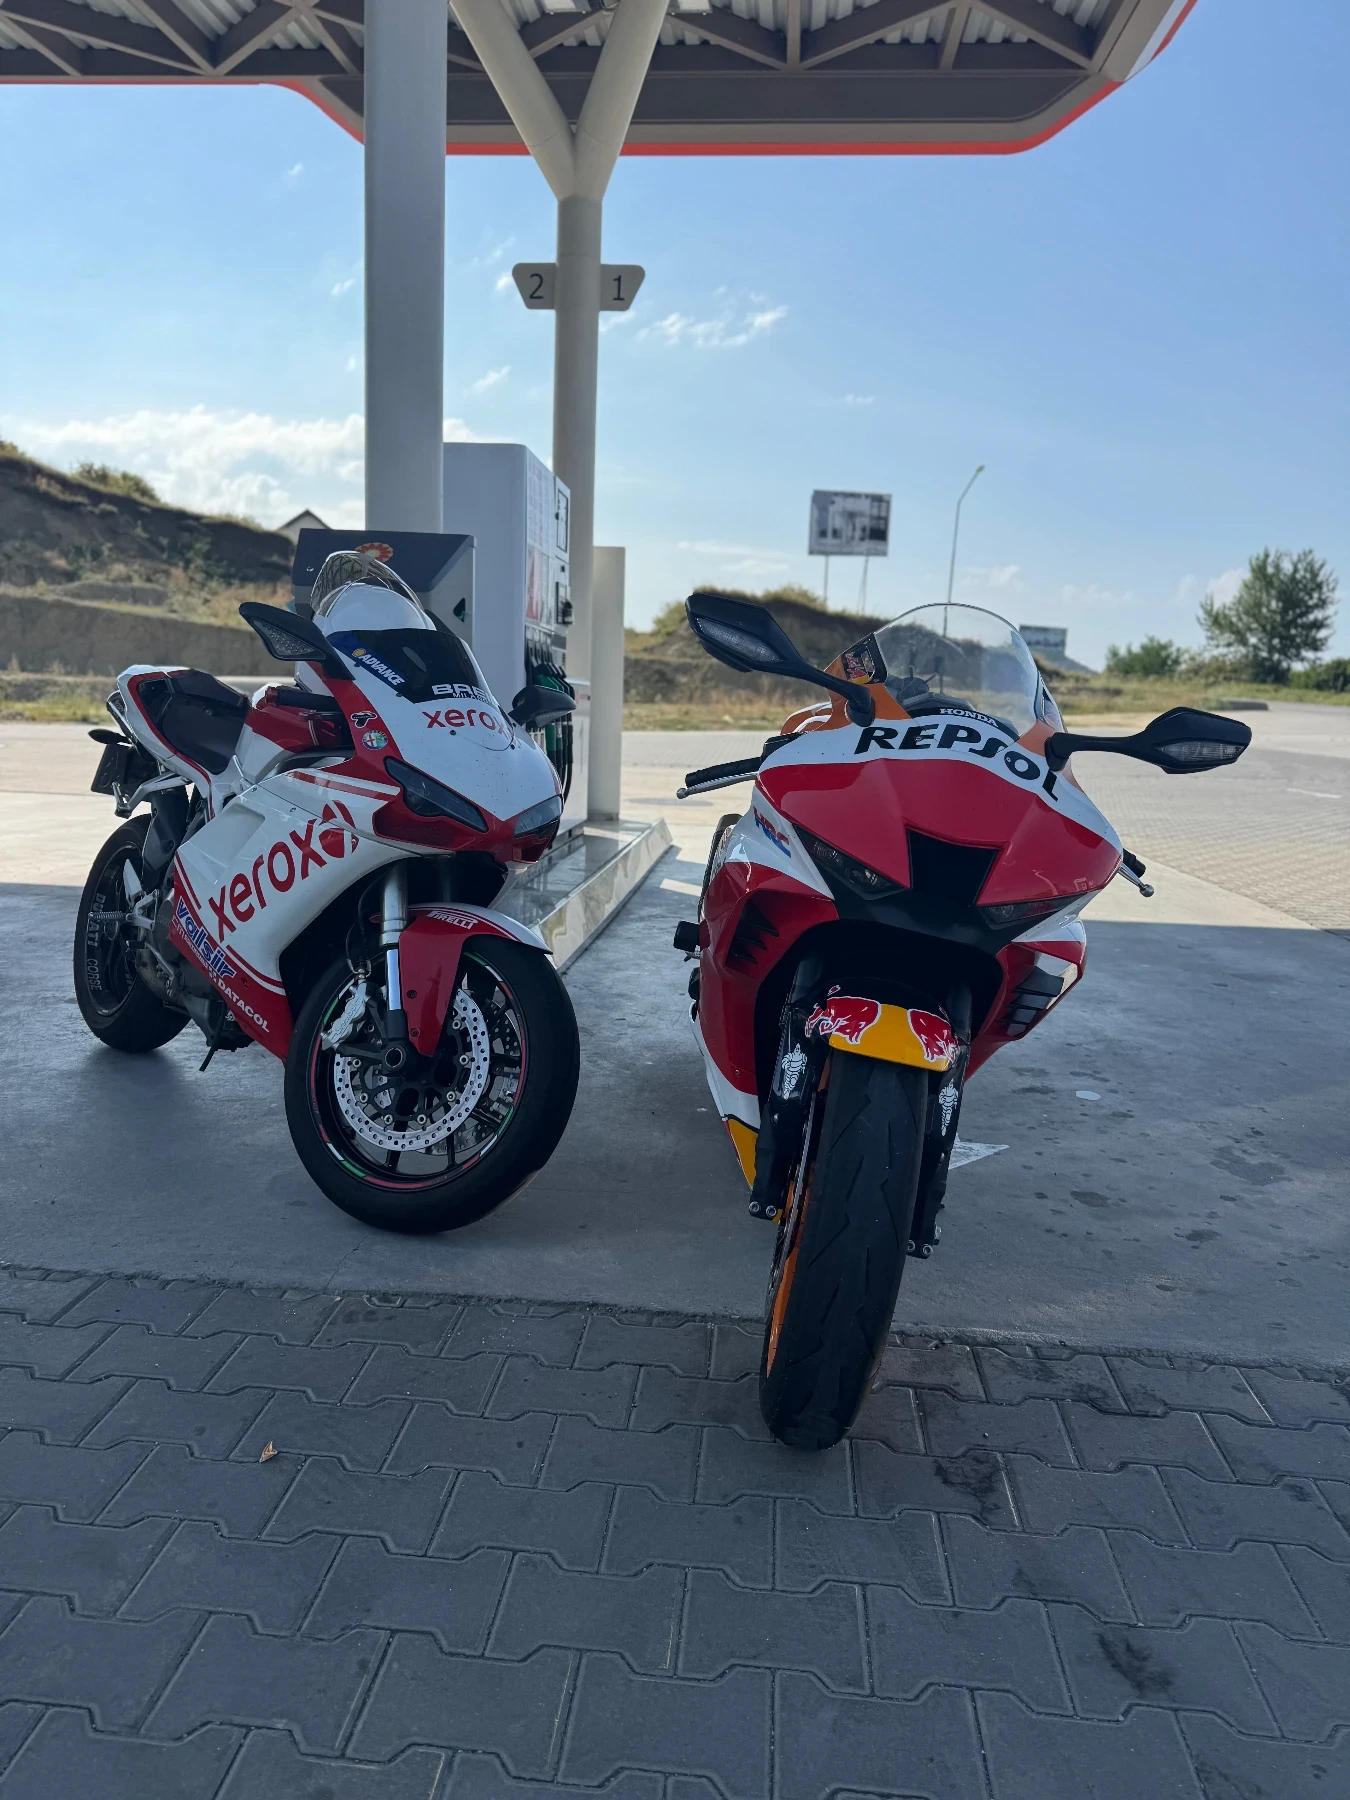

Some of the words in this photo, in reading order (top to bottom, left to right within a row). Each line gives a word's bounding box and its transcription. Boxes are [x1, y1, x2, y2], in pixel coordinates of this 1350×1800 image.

[529, 273, 544, 299] 2
[612, 274, 625, 301] 1
[359, 653, 406, 686] ADVANCE
[939, 707, 999, 728] HONDA
[854, 723, 1059, 802] REPSOL
[208, 819, 328, 943] xerox
[88, 893, 106, 947] DUATI
[426, 910, 478, 930] PIRELLI
[87, 958, 102, 991] CORSE
[217, 980, 270, 1033] DATACOL
